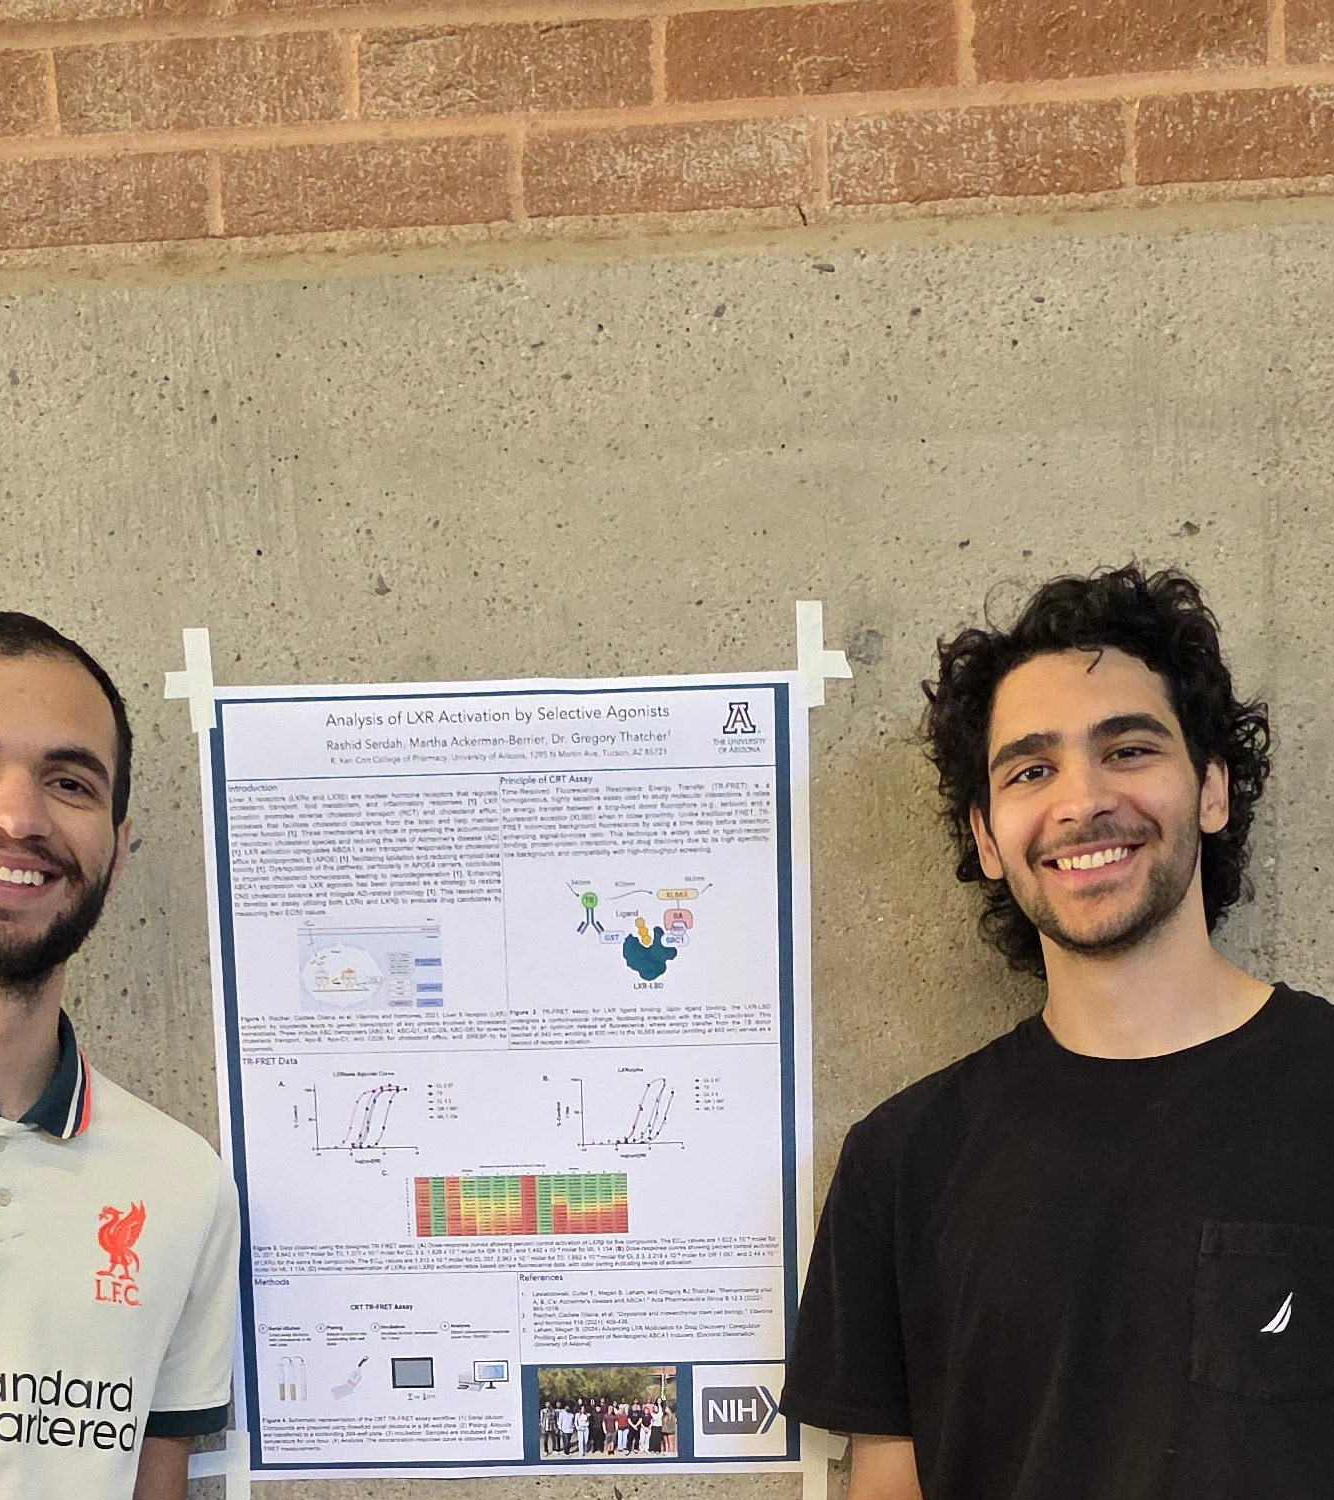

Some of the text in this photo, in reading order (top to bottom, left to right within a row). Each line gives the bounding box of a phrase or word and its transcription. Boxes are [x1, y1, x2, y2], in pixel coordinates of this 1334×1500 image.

[325, 705, 670, 730] Analysis of LXR Activation by Selective Agonists
[326, 738, 362, 751] Rashid
[365, 737, 406, 750] Serdah,
[410, 736, 447, 748] Martha
[551, 733, 567, 745] Dr.
[571, 732, 616, 746] Gregory
[373, 755, 401, 765] College
[403, 754, 411, 763] of
[451, 753, 487, 763] University
[489, 752, 496, 760] of
[500, 776, 536, 785] Principle
[549, 775, 567, 783] CRT
[568, 775, 593, 784] Assay
[228, 784, 278, 792] Introduction
[616, 910, 638, 918] Ligand
[242, 1057, 298, 1066] TR-FRET Data
[254, 1278, 289, 1286] Methods
[519, 1273, 564, 1282] References
[394, 1303, 413, 1311] Assay
[708, 1398, 757, 1423] NIH
